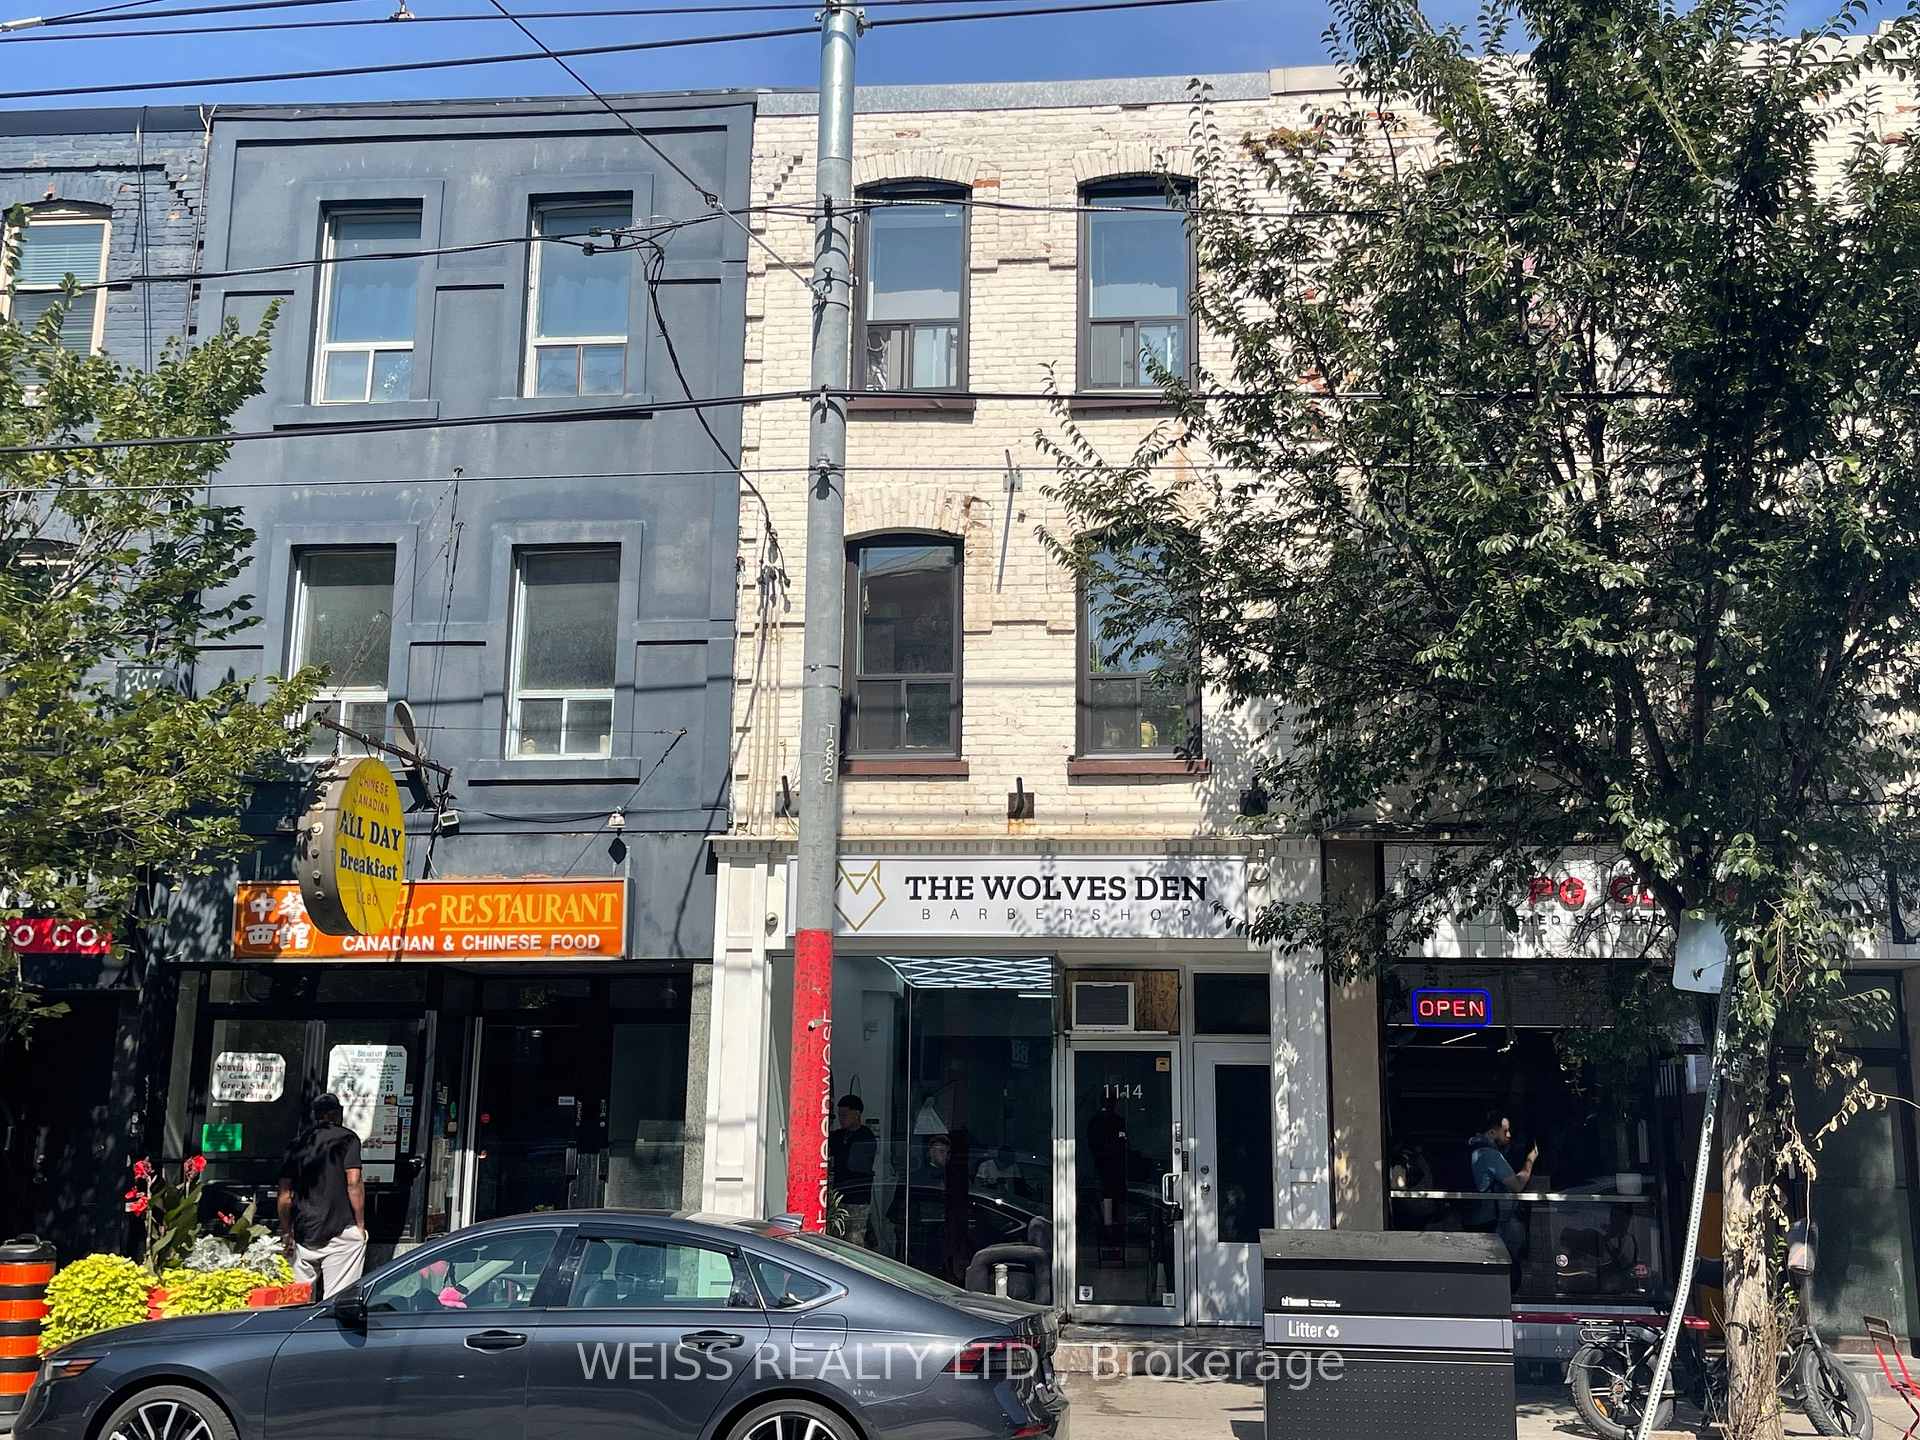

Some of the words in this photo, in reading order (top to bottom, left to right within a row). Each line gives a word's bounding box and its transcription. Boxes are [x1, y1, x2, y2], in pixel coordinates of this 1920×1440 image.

[339, 810, 366, 841] ALL
[369, 821, 402, 851] DAY
[340, 848, 399, 881] Breakfast
[905, 876, 974, 900] THE
[981, 876, 1127, 901] WOLVES
[1135, 876, 1207, 901] DEN
[440, 892, 618, 925] RESTAURANT
[922, 908, 1191, 920] BARBERSHOP
[52, 924, 106, 947] CO.
[341, 935, 435, 952] CANADIAN
[443, 936, 455, 951] &
[462, 934, 541, 950] CHINESE
[551, 934, 600, 950] FOOD
[1419, 999, 1484, 1018] OPEN
[1103, 1084, 1144, 1099] 1114
[1288, 1320, 1324, 1338] Litter
